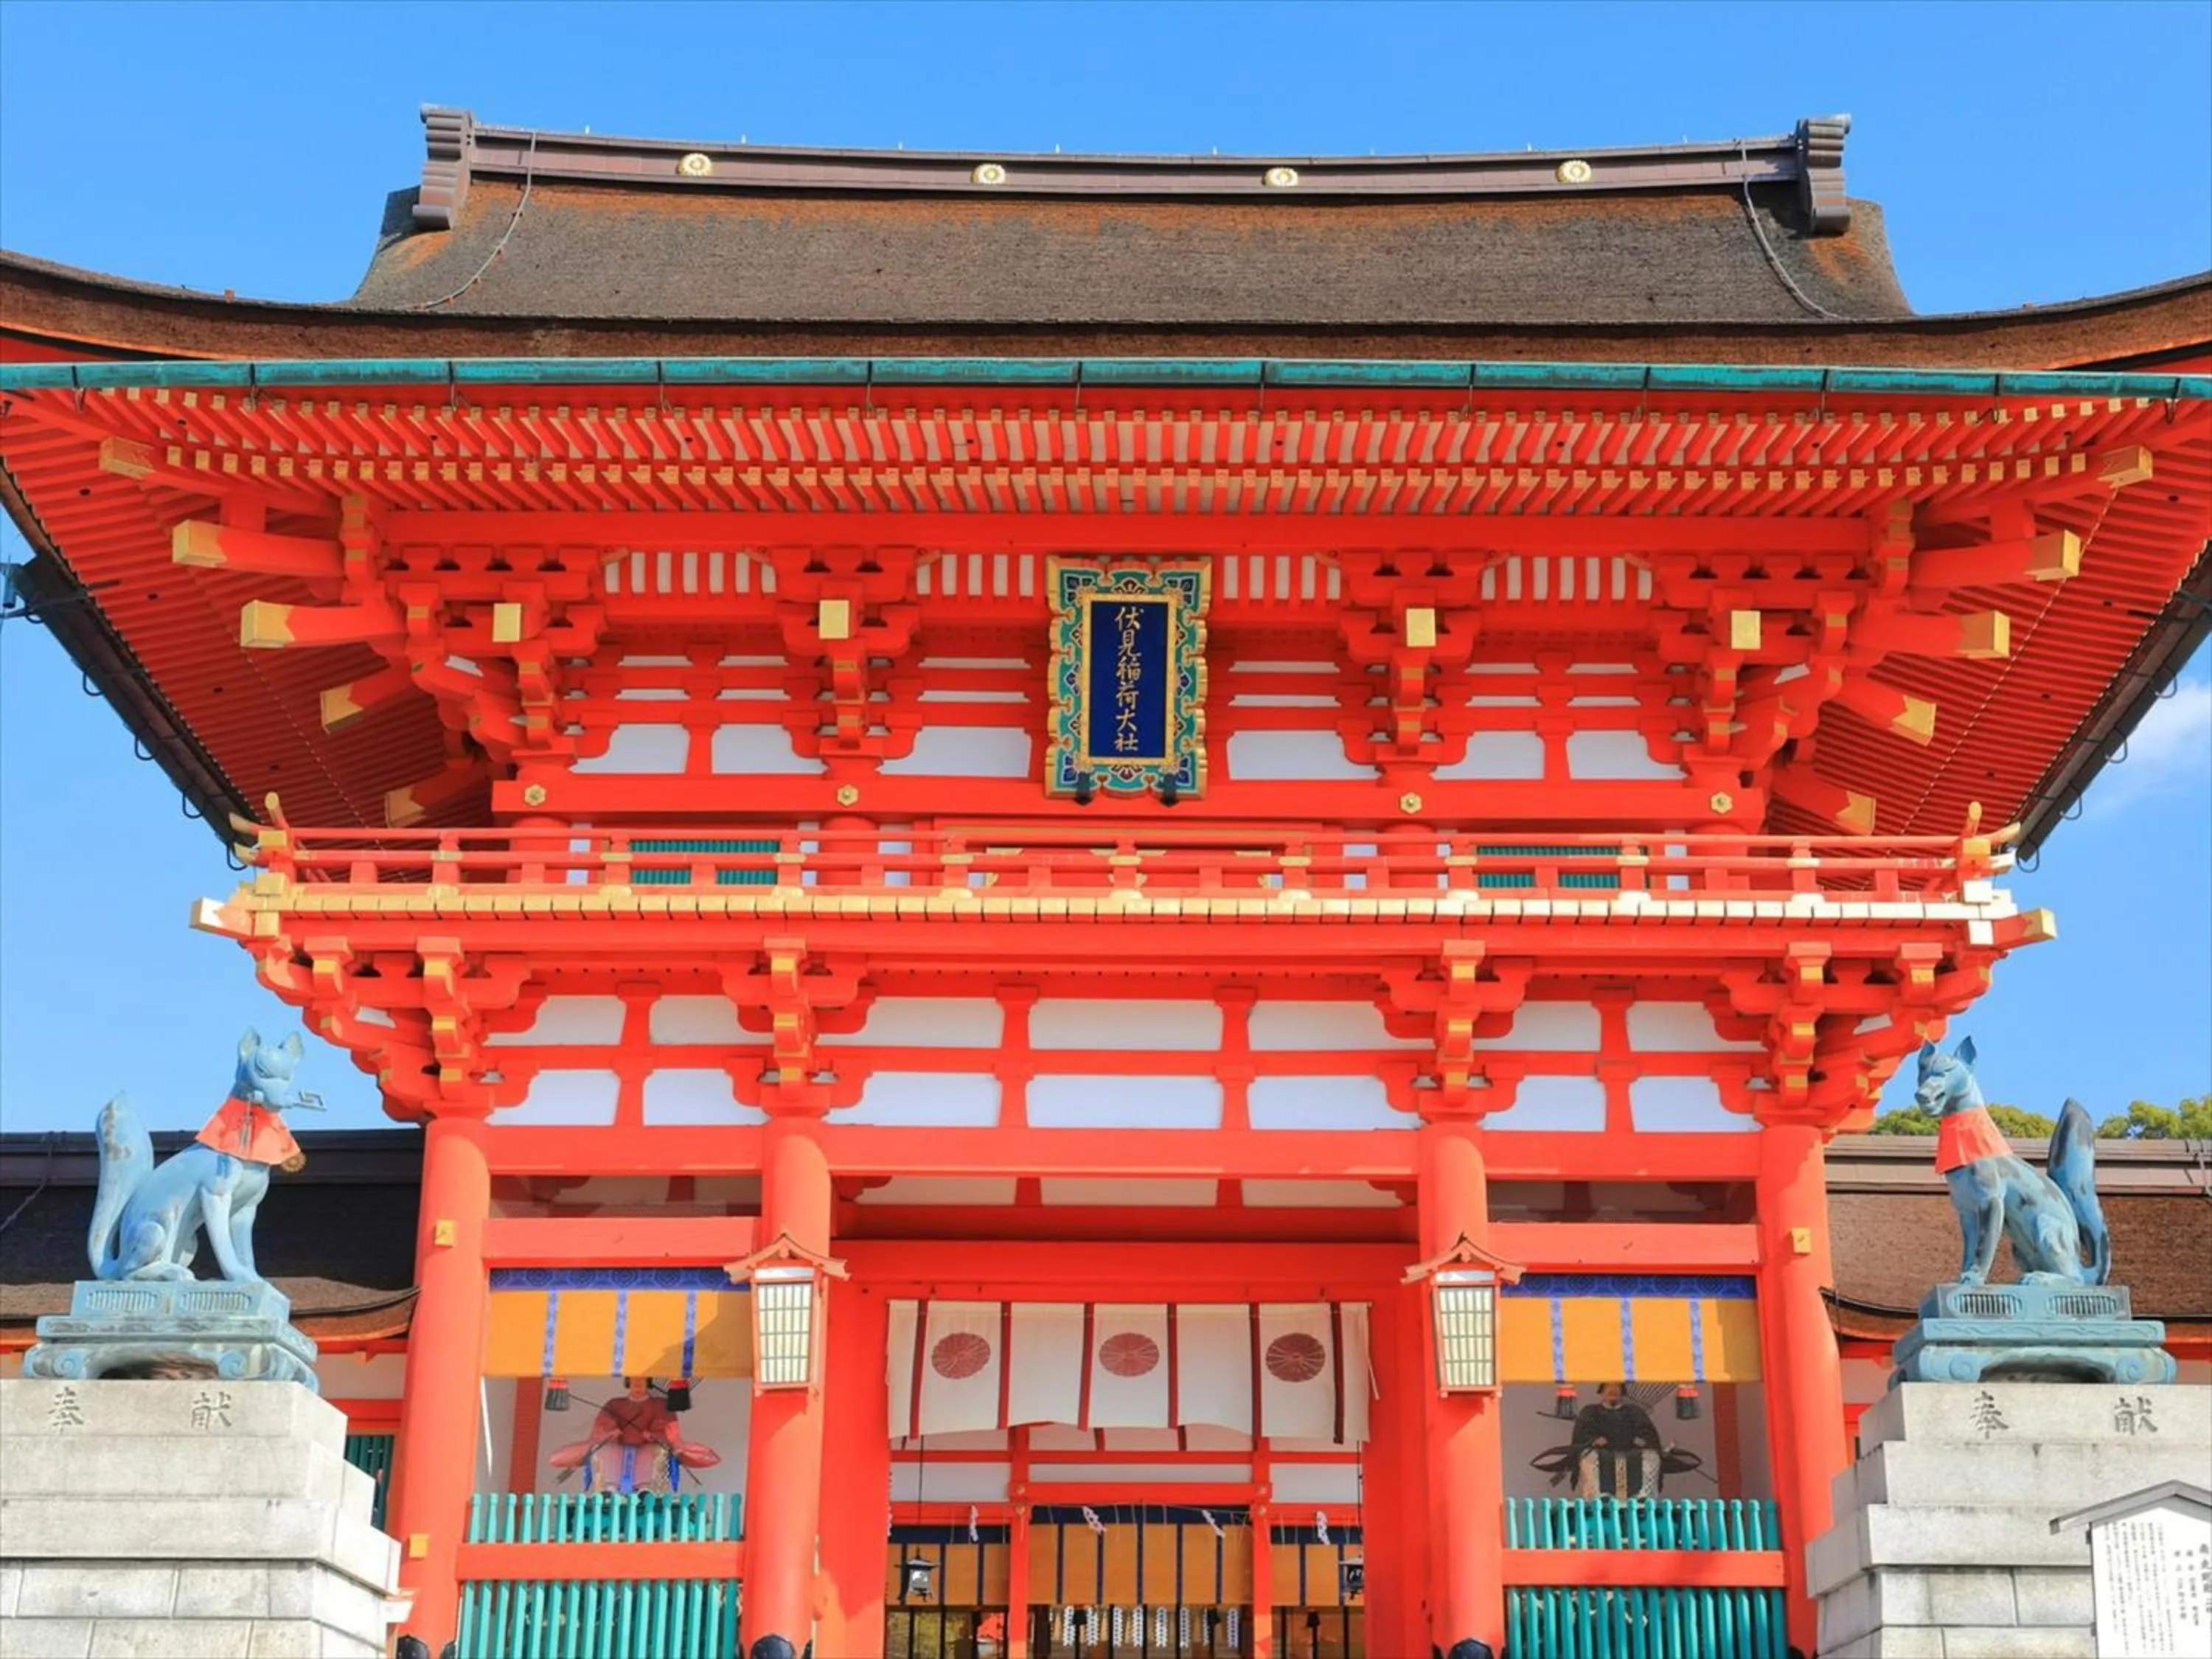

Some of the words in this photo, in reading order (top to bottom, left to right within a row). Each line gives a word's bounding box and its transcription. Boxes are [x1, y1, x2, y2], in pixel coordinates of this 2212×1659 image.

[1114, 605, 1144, 752] 伏見稲荷大社
